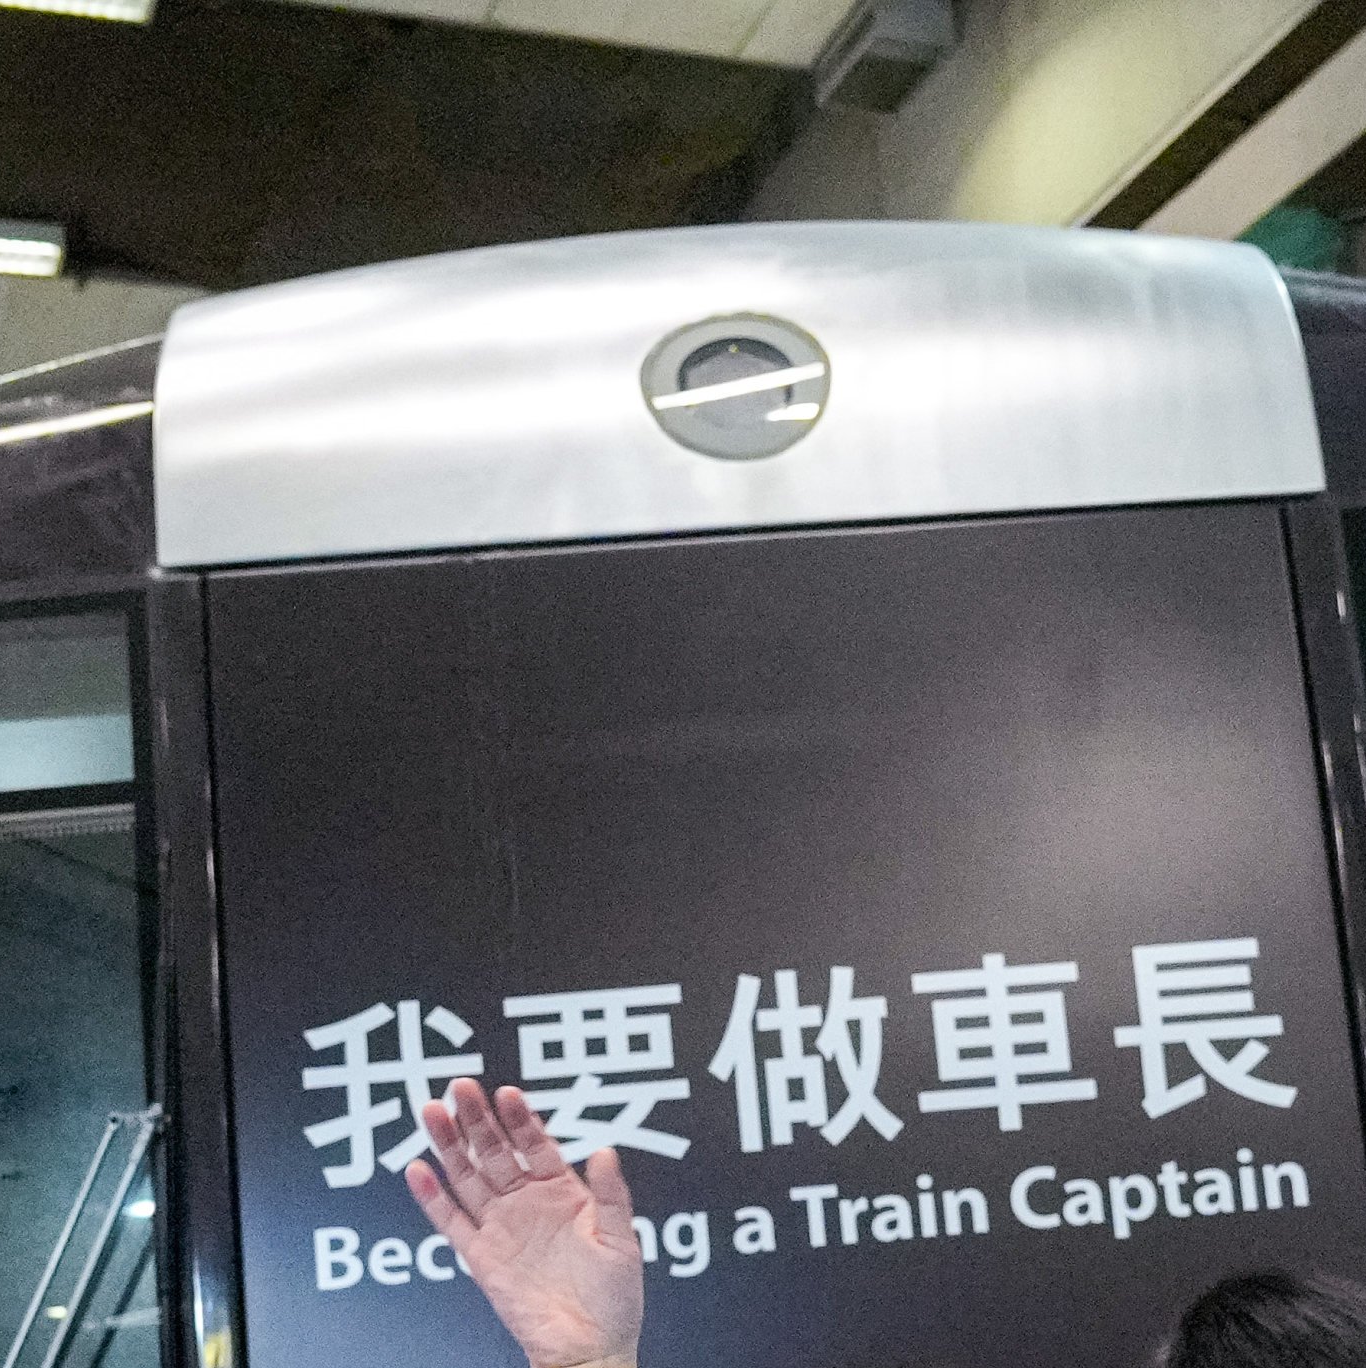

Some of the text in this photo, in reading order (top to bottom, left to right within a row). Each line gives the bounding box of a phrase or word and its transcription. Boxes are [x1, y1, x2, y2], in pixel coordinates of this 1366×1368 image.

[301, 937, 1298, 1190] 我要做車長
[313, 1147, 1311, 1291] Becng a Train Captain
